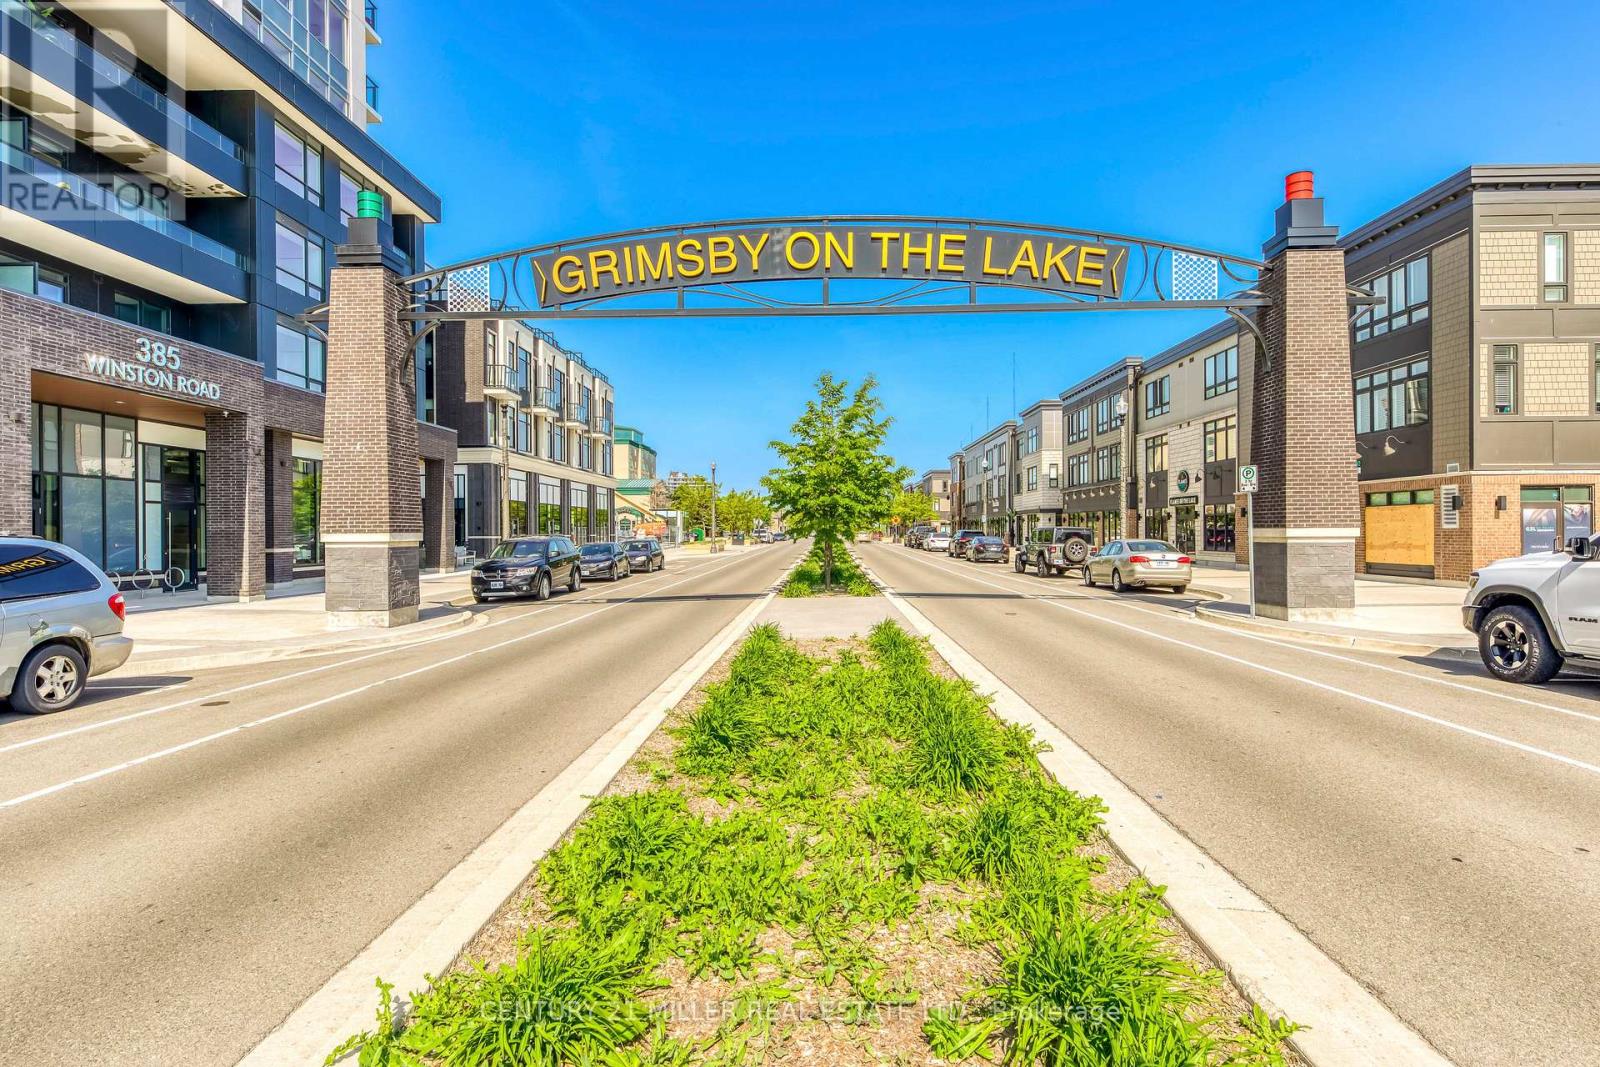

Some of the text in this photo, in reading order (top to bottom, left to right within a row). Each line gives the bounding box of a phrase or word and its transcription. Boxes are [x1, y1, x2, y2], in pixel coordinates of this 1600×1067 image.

[552, 231, 1108, 294] GRIMSBY ON THE LAKE
[84, 351, 221, 400] WINSTON ROAD
[135, 337, 181, 370] 385
